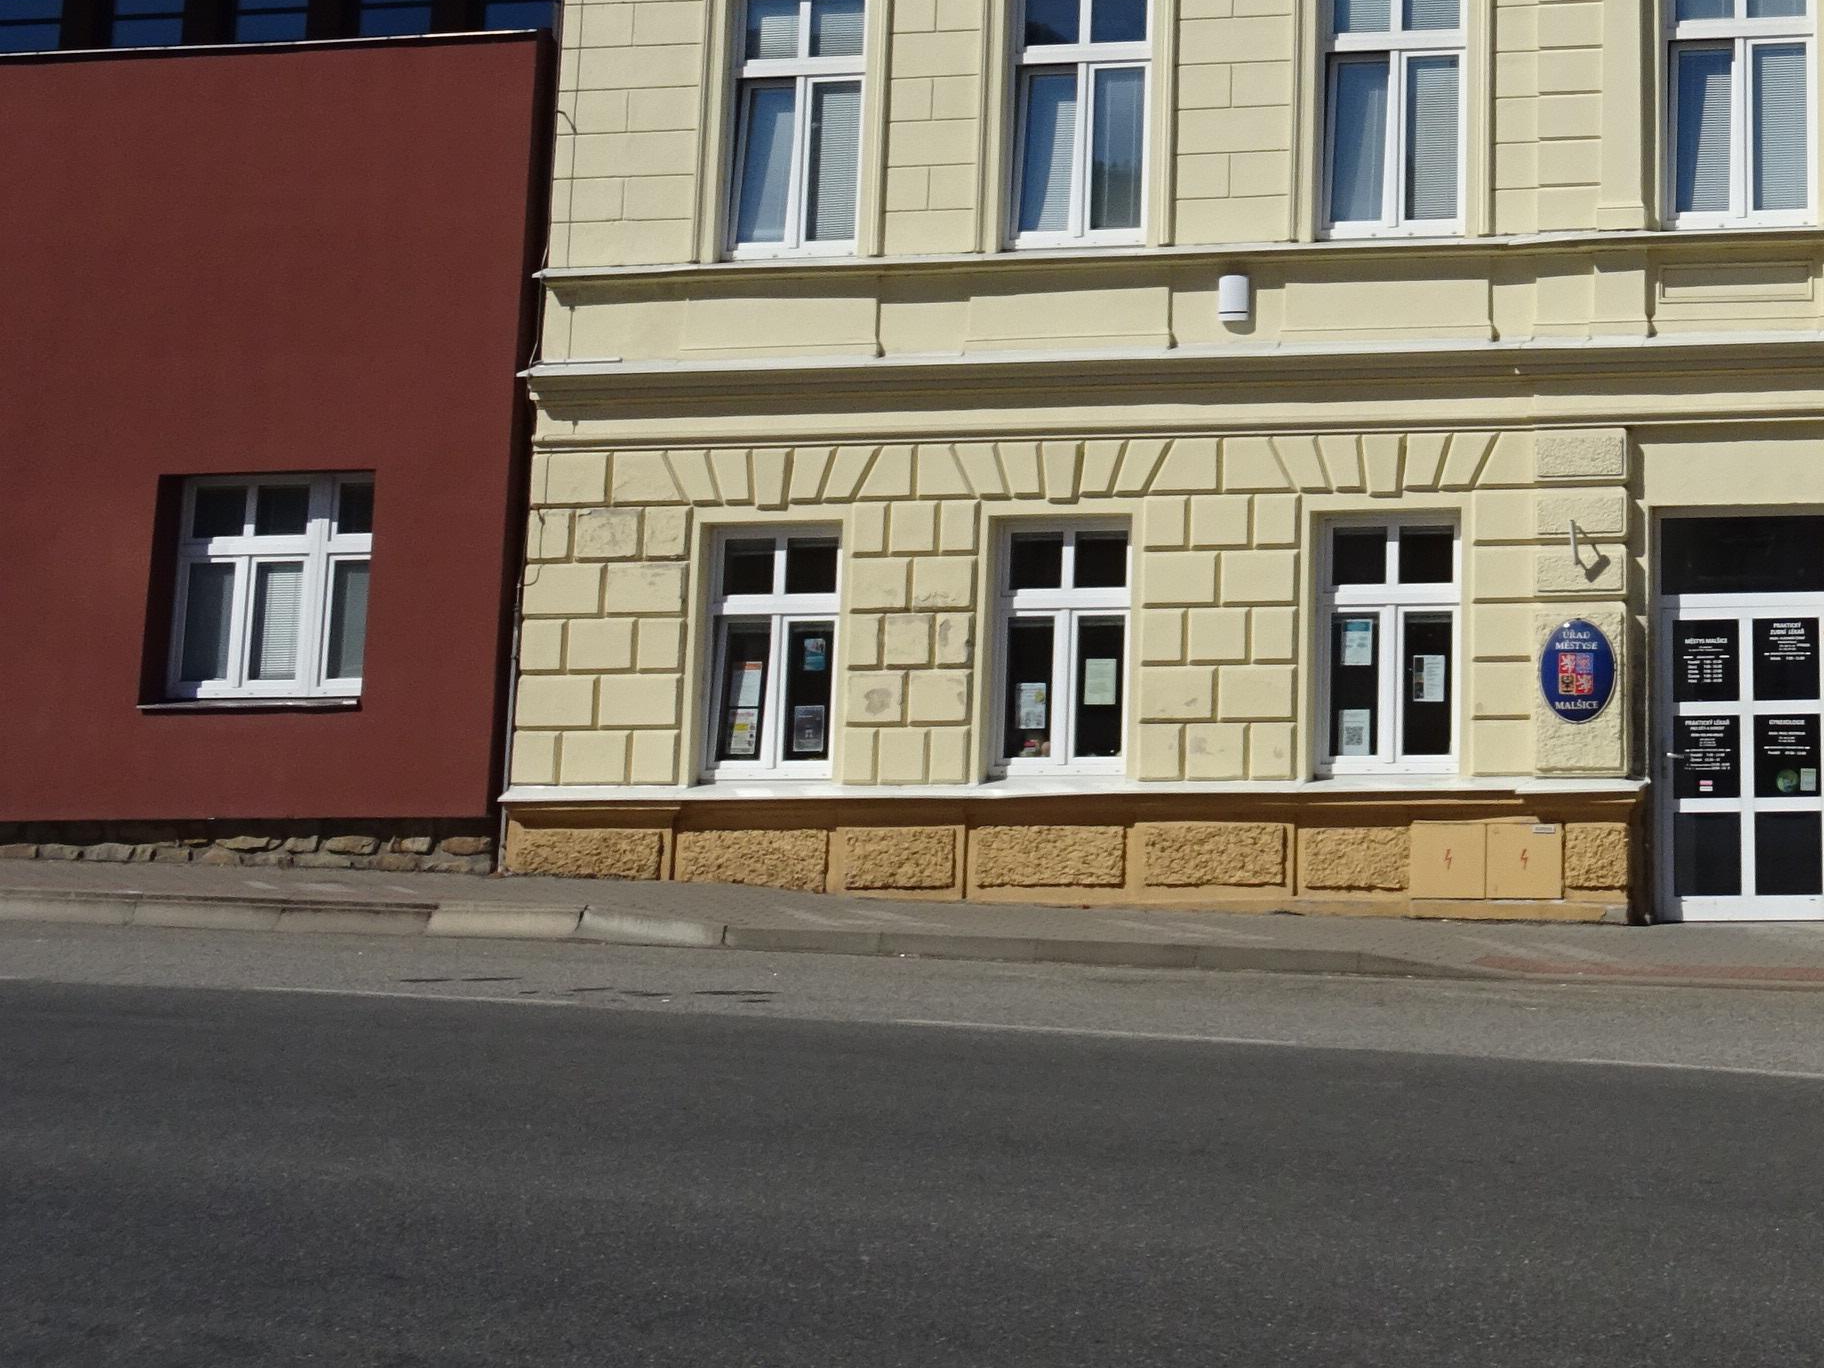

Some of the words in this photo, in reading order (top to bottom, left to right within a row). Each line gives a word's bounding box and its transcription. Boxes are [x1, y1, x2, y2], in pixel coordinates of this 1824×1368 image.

[1562, 629, 1590, 639] ÚŘAD
[1555, 640, 1598, 649] MĚSTYSE
[1555, 699, 1599, 709] MALŠICE
